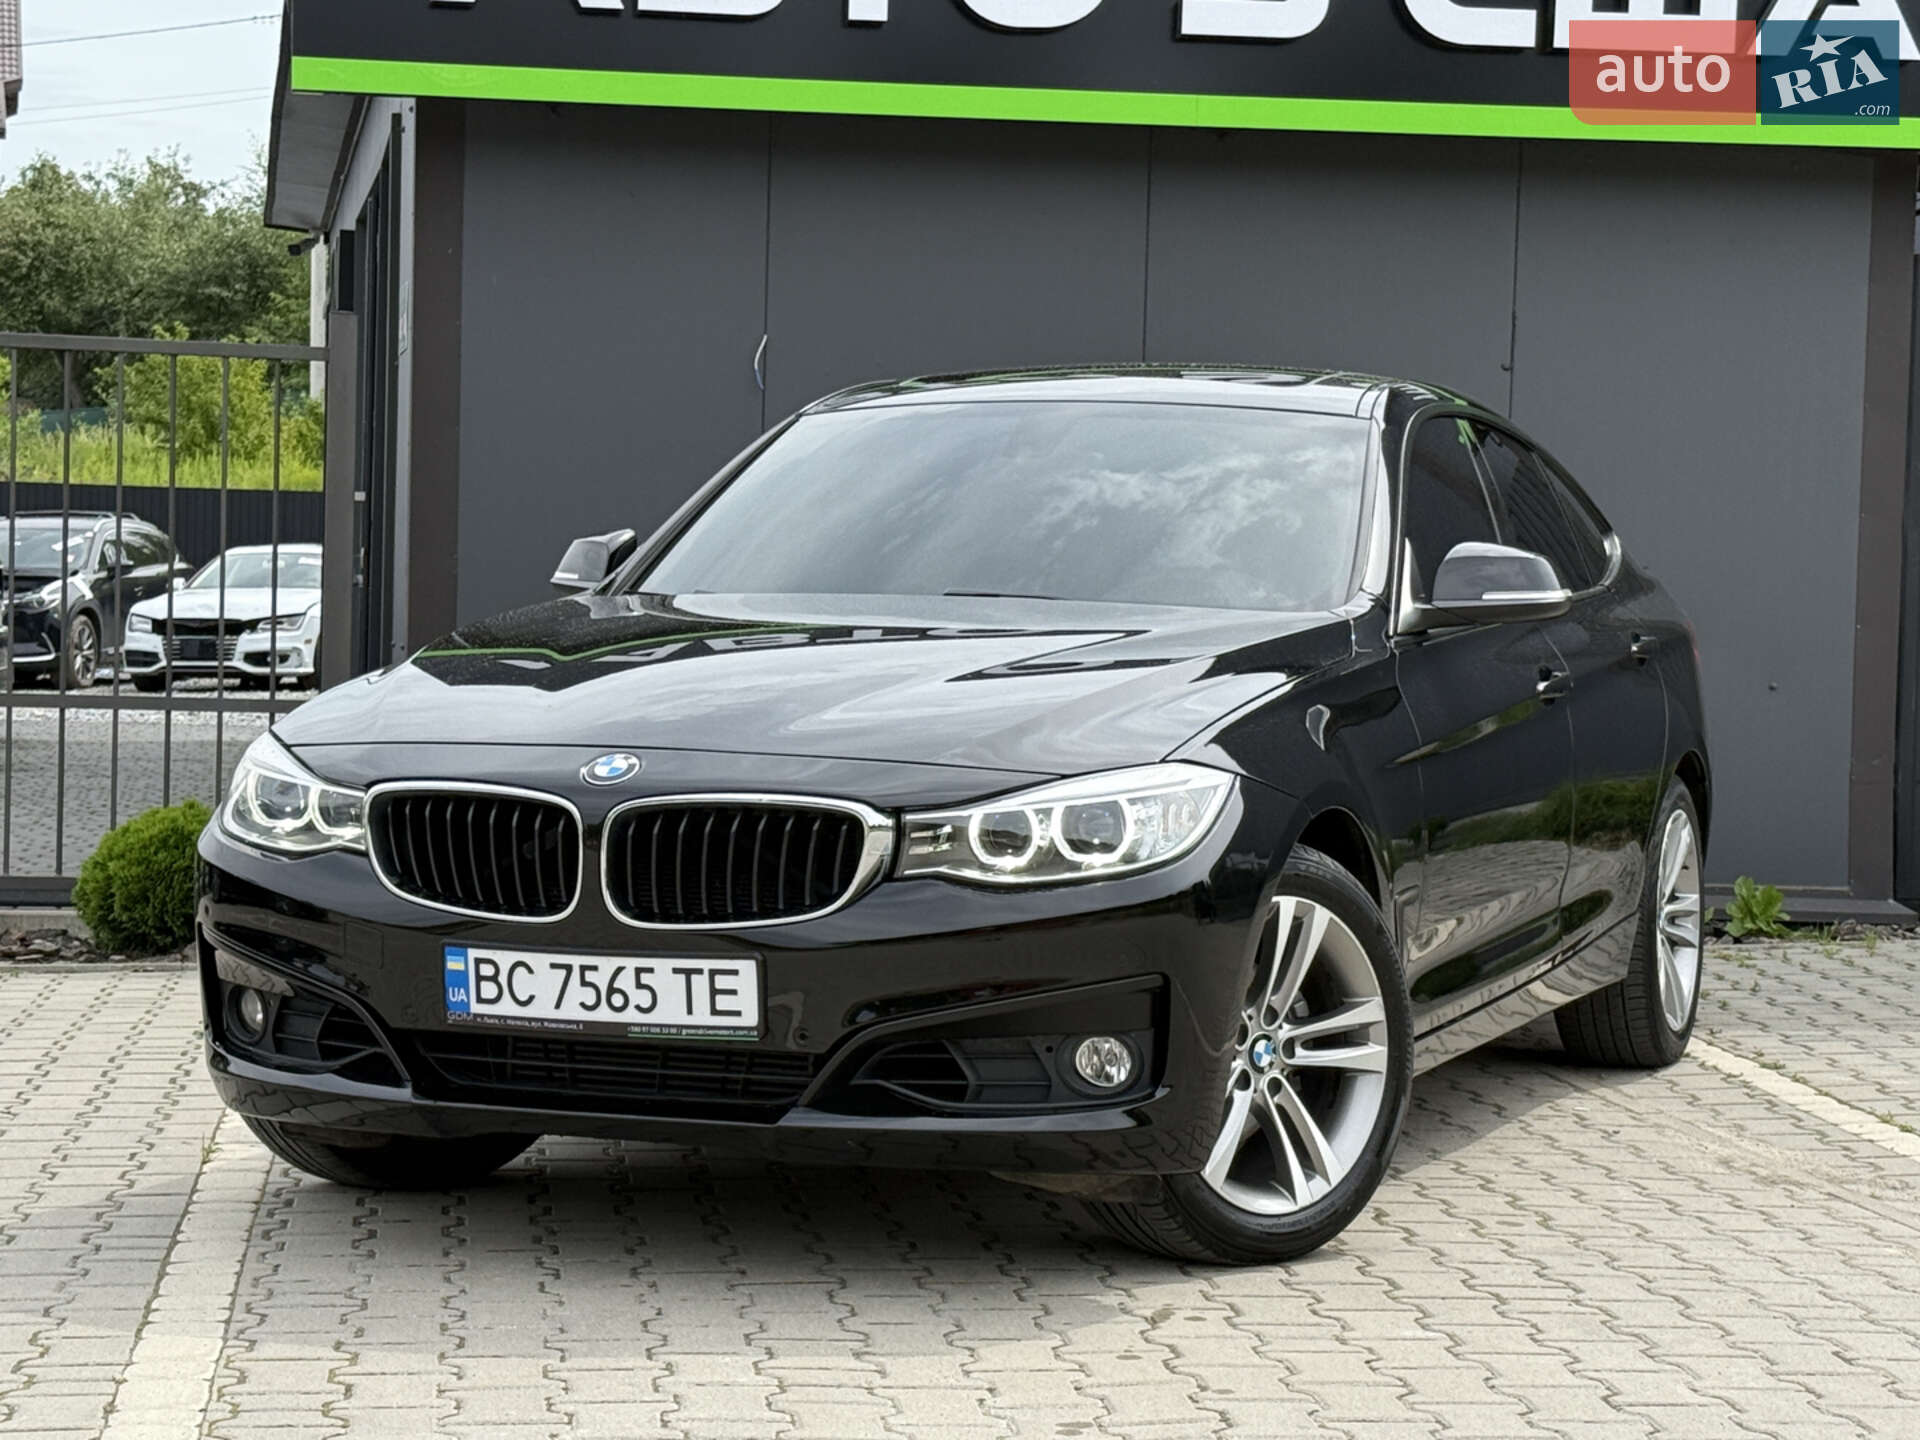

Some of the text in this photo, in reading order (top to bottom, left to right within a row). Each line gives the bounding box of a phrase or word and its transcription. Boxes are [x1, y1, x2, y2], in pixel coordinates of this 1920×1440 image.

[448, 987, 468, 1003] UA
[474, 957, 743, 1017] BC 7565 TE
